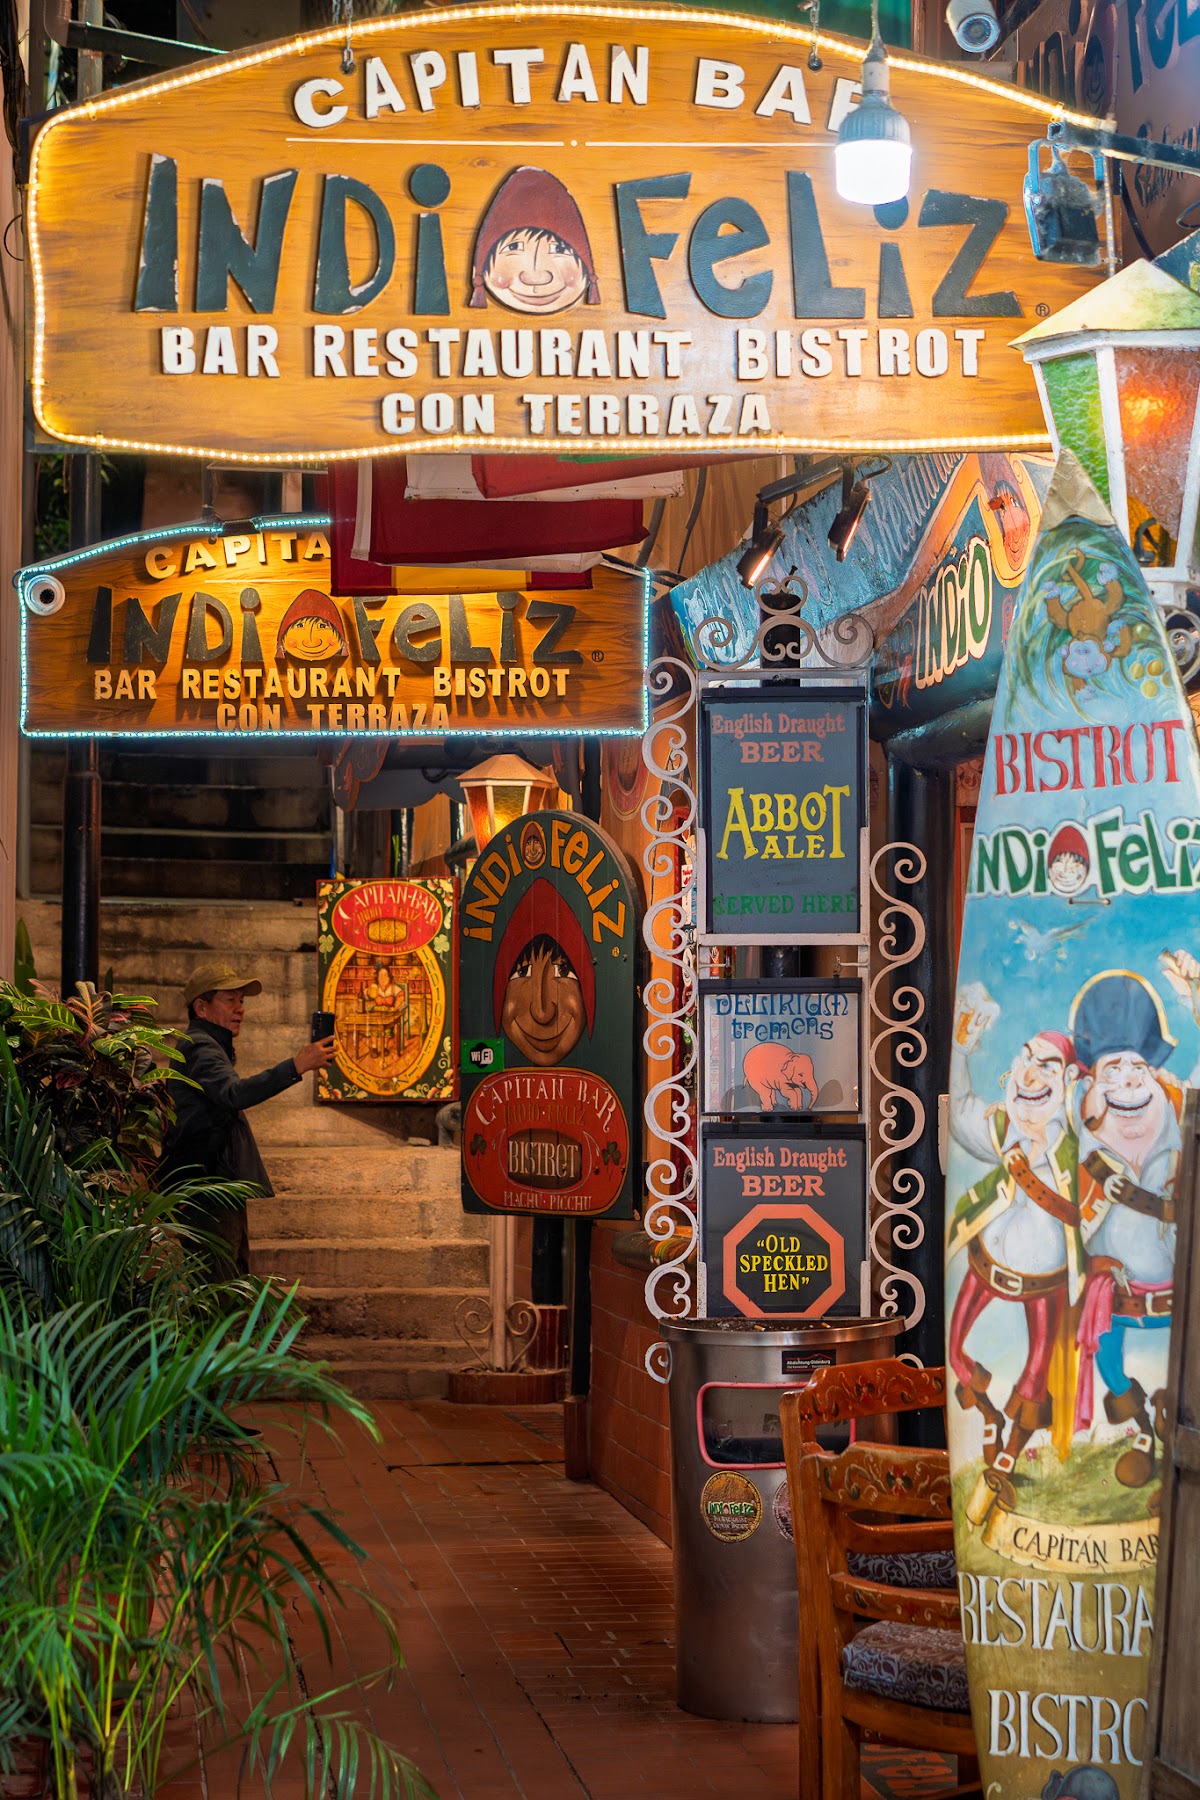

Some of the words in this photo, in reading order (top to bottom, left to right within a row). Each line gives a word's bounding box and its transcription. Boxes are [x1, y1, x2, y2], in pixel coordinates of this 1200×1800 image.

[294, 45, 649, 128] CAPITAN
[162, 325, 280, 377] BAR
[313, 324, 691, 379] RESTAURANT
[737, 328, 986, 380] BISTROT
[381, 393, 496, 436] CON
[523, 392, 772, 437] TERRAZA
[145, 530, 332, 580] CAPITA
[94, 669, 157, 700] BAR
[182, 667, 400, 700] RESTAURANT
[433, 667, 570, 699] BISTROT
[217, 703, 274, 731] CON
[307, 703, 450, 731] TERRAZA
[711, 713, 774, 741] English
[778, 712, 846, 740] Draught
[740, 741, 824, 764] BEER
[992, 719, 1184, 799] BISTROT
[716, 784, 850, 860] ABBOT
[760, 835, 825, 860] ALE
[1094, 813, 1200, 895] FeLi
[712, 894, 796, 916] SERVED
[801, 893, 857, 914] HERE
[714, 993, 849, 1016] DELIRIUM
[475, 1076, 564, 1126] CAPITAN
[577, 1080, 617, 1133] BAR
[508, 1140, 579, 1178] BISTROT
[713, 1146, 775, 1173] English
[779, 1146, 847, 1173] Draught
[503, 1190, 543, 1209] MACHU
[741, 1175, 825, 1197] BEER
[739, 1255, 828, 1274] SPECKLED
[957, 1571, 1154, 1657] RESTAURA
[987, 1689, 1149, 1767] BISTRO
